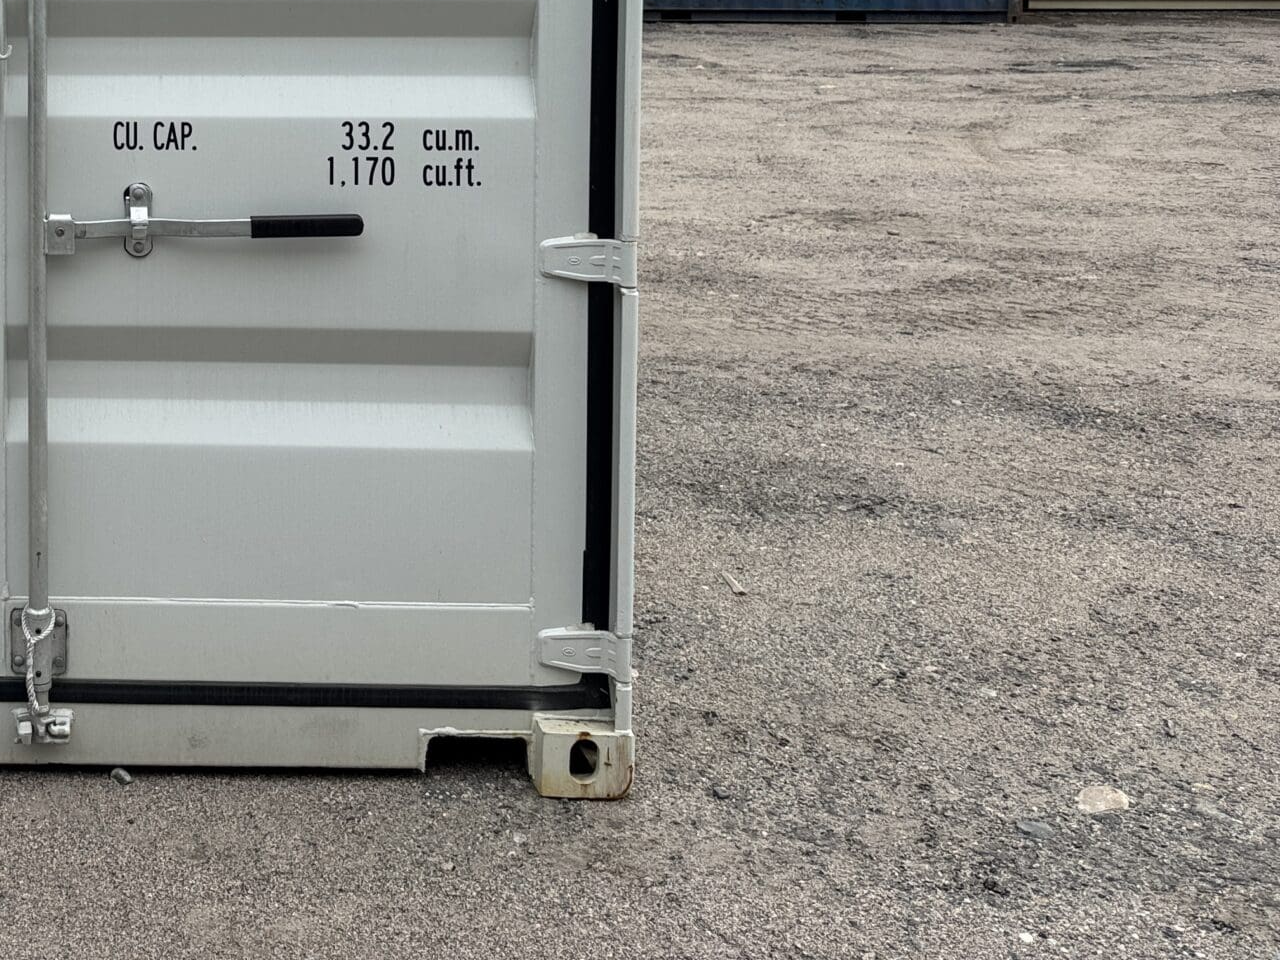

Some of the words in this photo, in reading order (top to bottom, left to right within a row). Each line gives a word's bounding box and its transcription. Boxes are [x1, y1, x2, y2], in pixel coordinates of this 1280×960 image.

[113, 121, 144, 151] CU.
[153, 121, 198, 152] CAP.
[341, 121, 395, 151] 33.2
[422, 128, 480, 152] cu.m.
[327, 156, 396, 187] 1,170
[422, 158, 482, 187] cu.ft.
